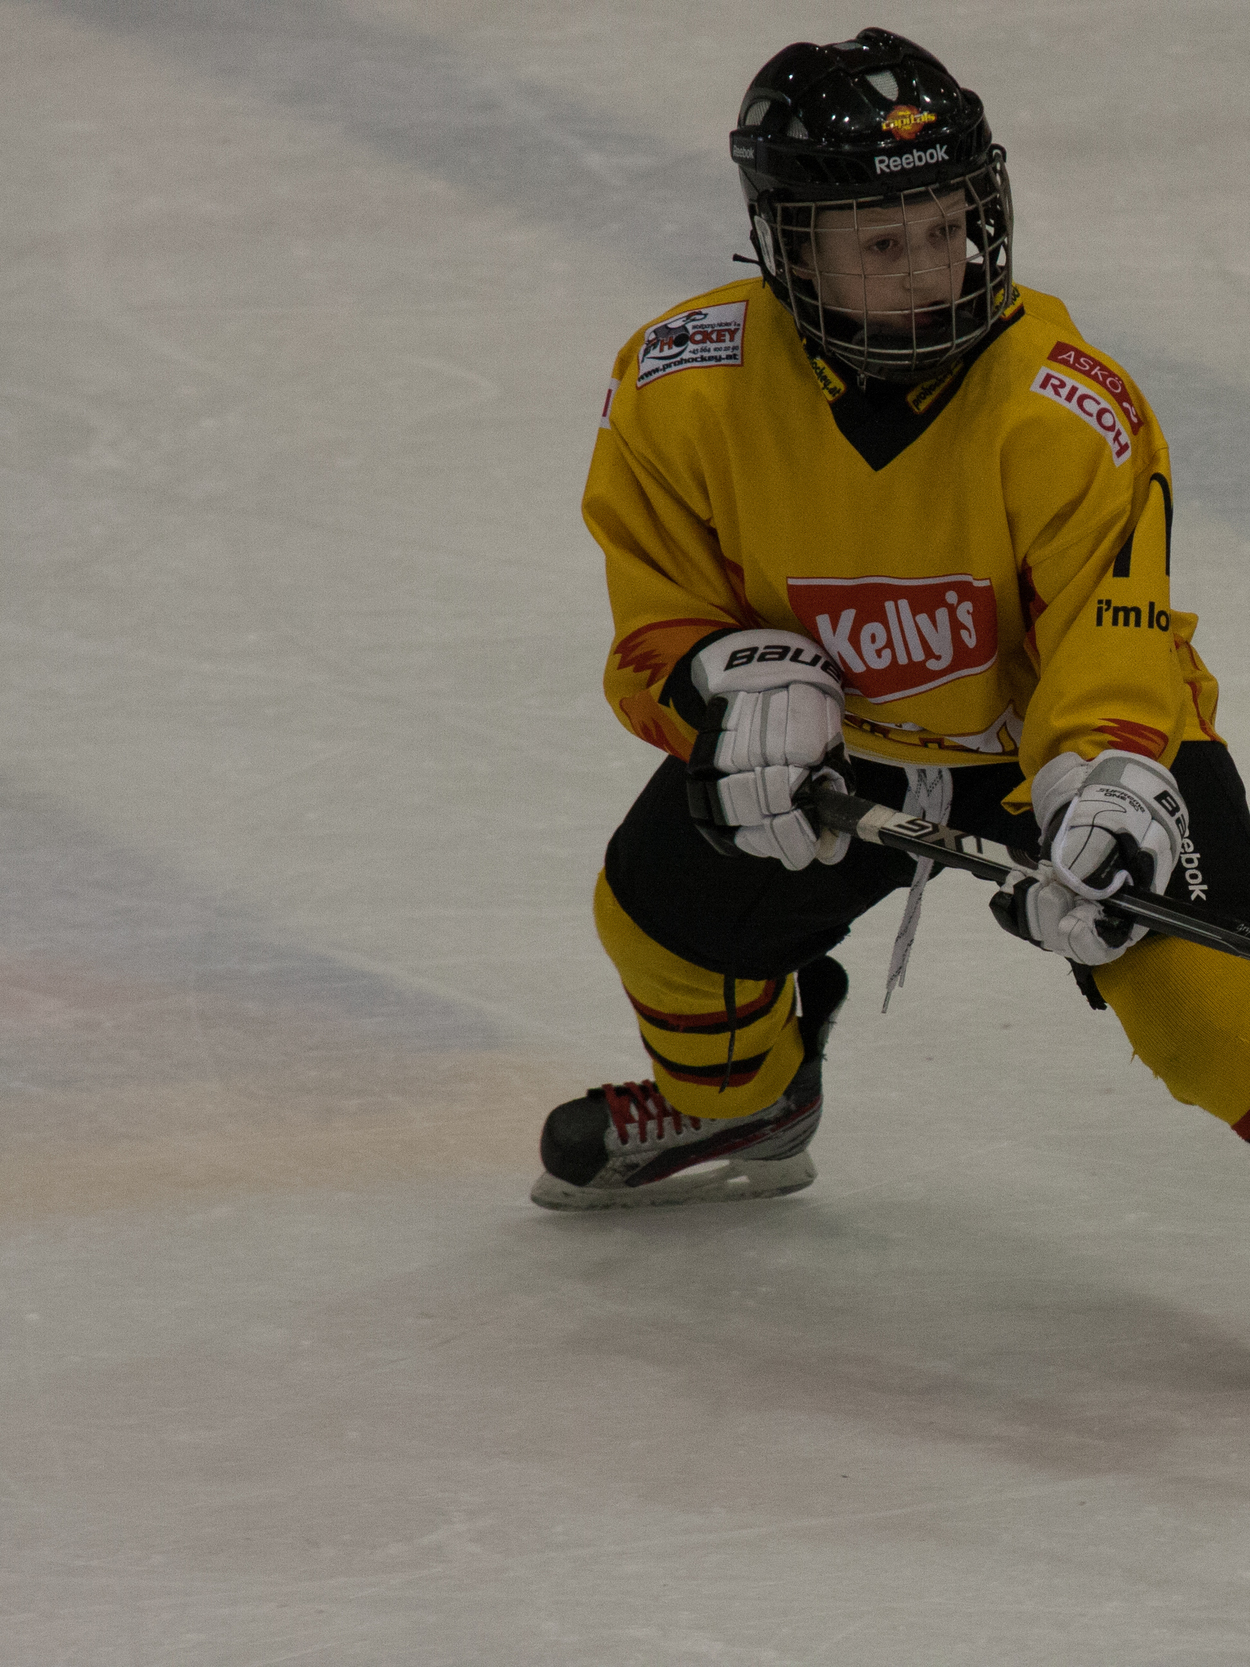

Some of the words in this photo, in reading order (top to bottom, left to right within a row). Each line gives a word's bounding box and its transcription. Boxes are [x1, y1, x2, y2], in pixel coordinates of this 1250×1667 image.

[732, 145, 755, 160] Reebok
[874, 144, 949, 175] Reebok
[638, 353, 740, 382] www.prohockey.at
[1057, 350, 1122, 394] ASKÖ
[1039, 372, 1130, 459] RICOH
[1096, 599, 1142, 628] i'm
[815, 590, 977, 674] Kelly's
